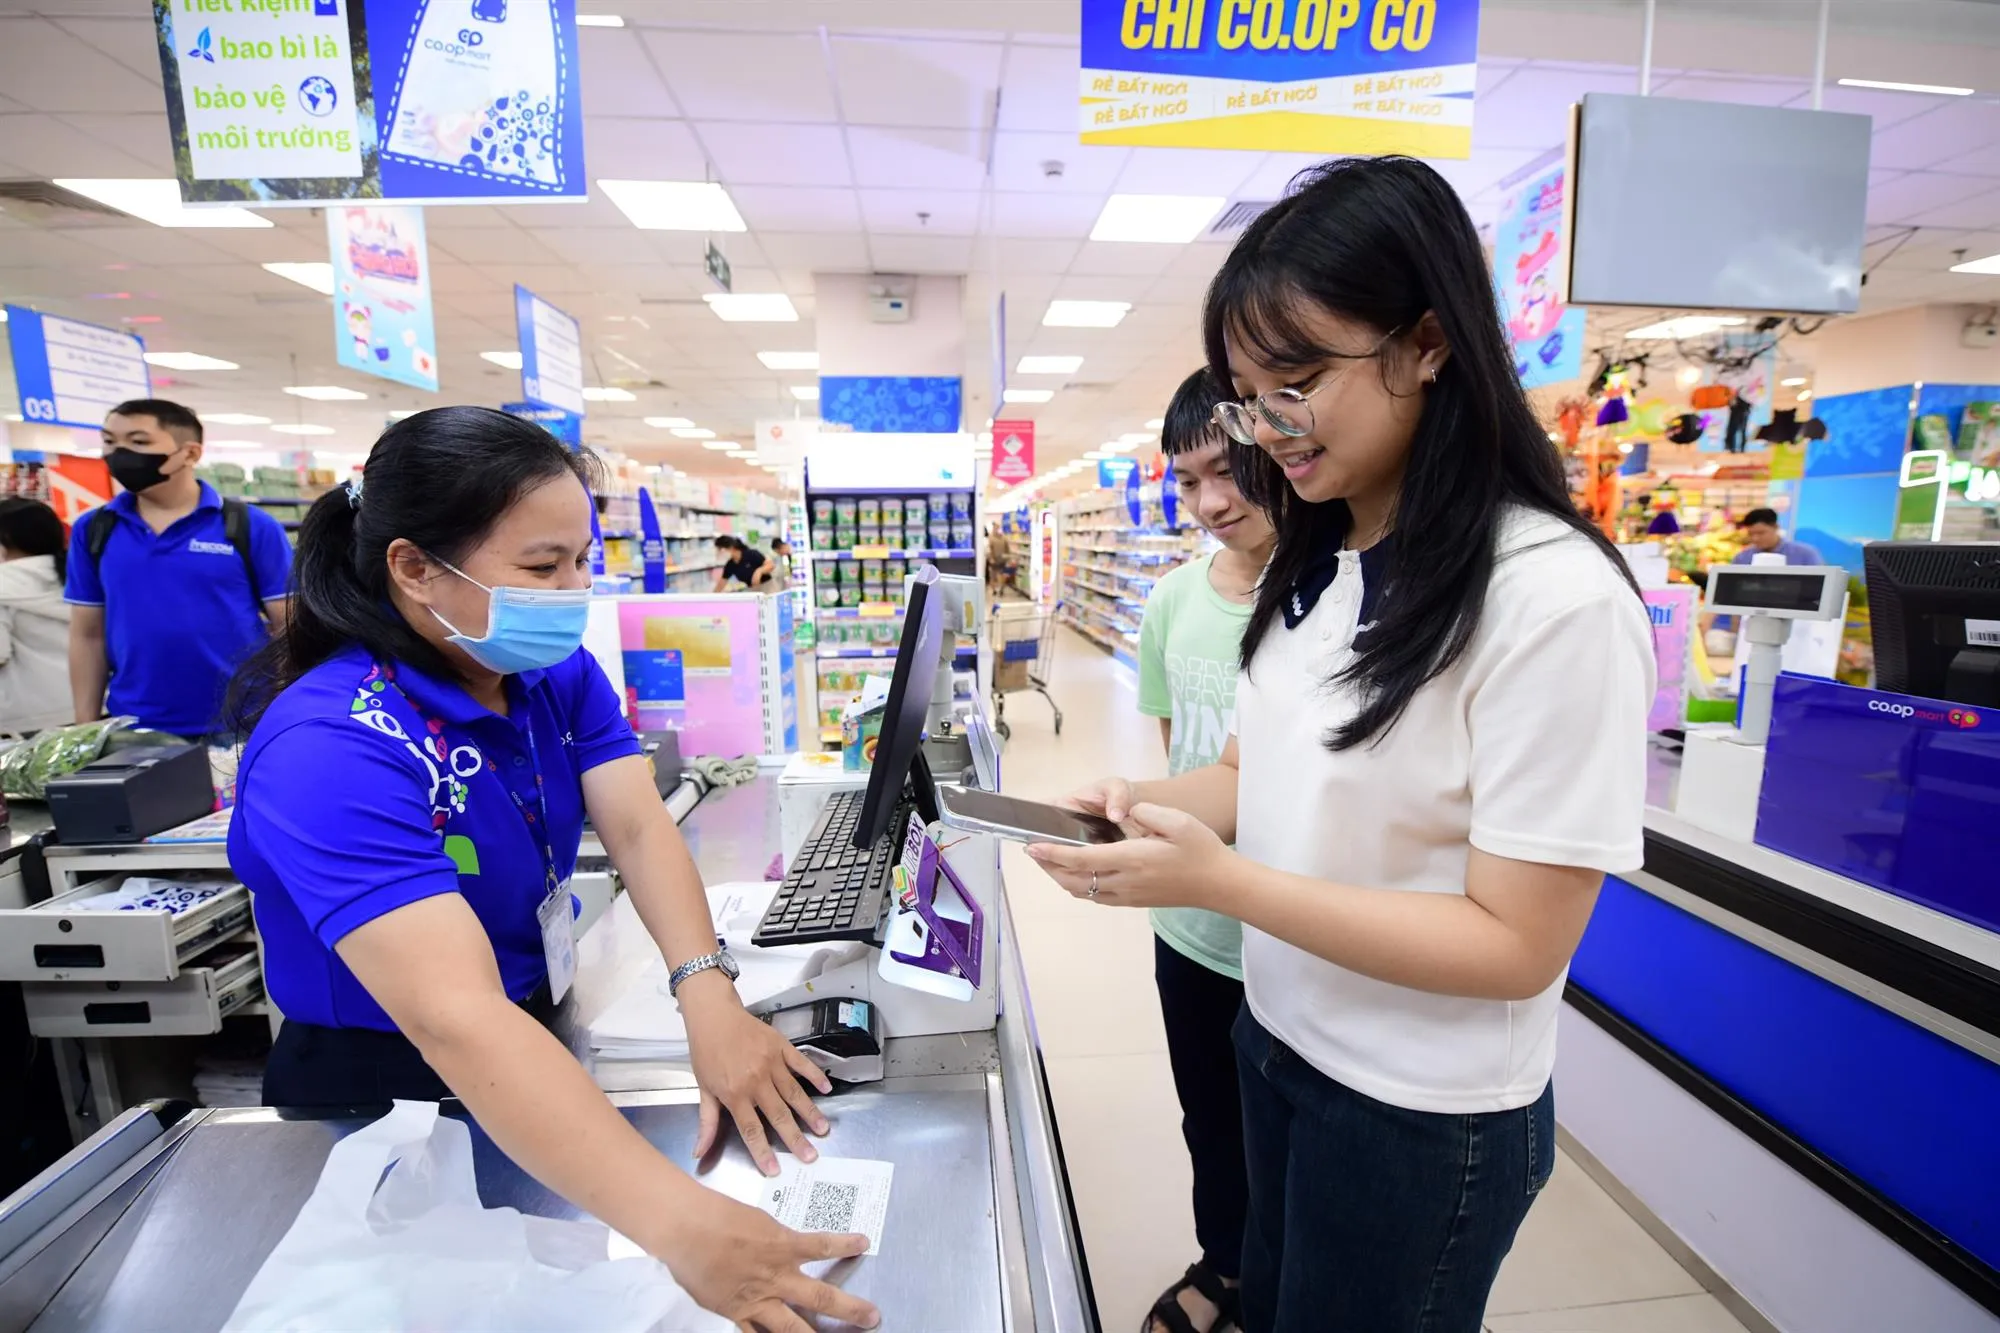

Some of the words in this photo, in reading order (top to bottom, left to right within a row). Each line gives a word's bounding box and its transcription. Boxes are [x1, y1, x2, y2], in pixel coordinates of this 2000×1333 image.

[1216, 0, 1361, 51] CO.OP
[219, 35, 273, 60] bao
[279, 34, 307, 60] bì
[311, 34, 339, 59] là
[193, 83, 247, 110] bảo
[252, 84, 287, 115] vệ
[196, 124, 249, 150] môi
[255, 124, 352, 153] trường
[24, 397, 56, 421] 03
[1868, 699, 1915, 719] co.op
